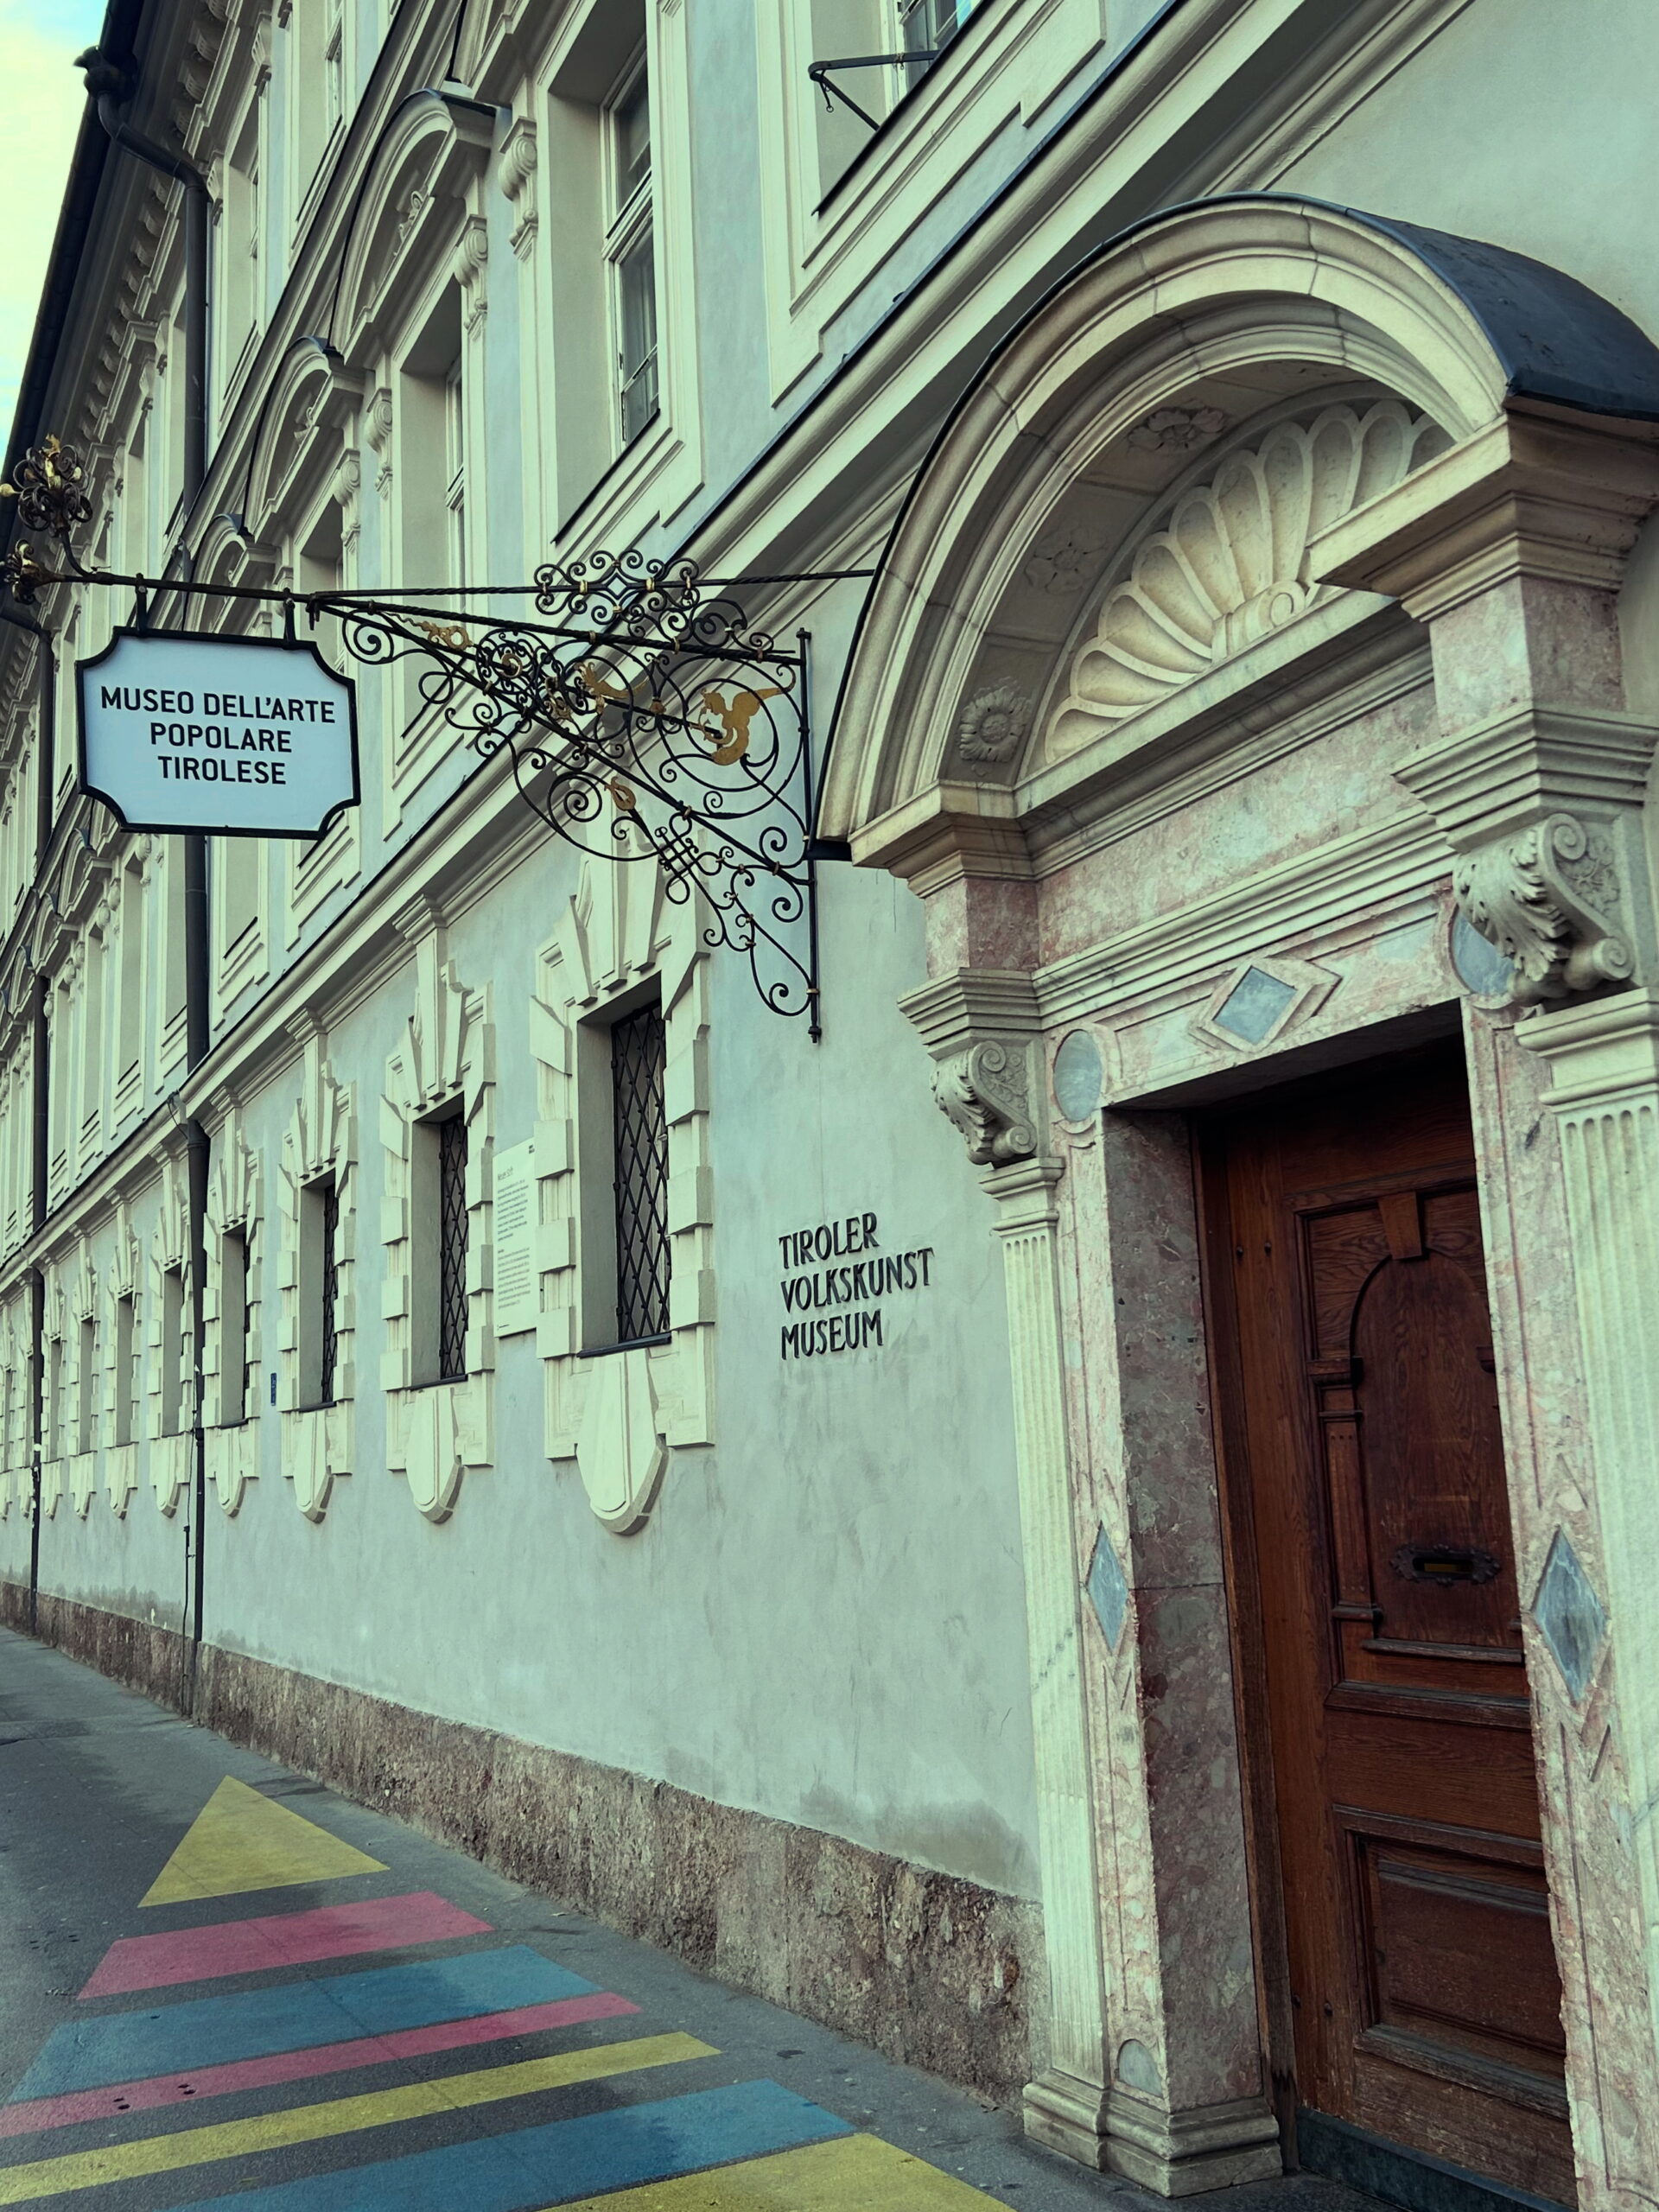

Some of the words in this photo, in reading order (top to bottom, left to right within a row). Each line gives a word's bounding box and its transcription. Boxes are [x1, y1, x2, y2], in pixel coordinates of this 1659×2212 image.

[101, 686, 194, 715] MUSEO
[203, 692, 335, 723] DELL'ARTE
[150, 722, 292, 753] POPOLARE
[158, 755, 286, 785] TIROLESE
[779, 1211, 880, 1269] TIROLER
[780, 1247, 935, 1313] VOLKSKUNST
[781, 1308, 884, 1360] MUSEUM
